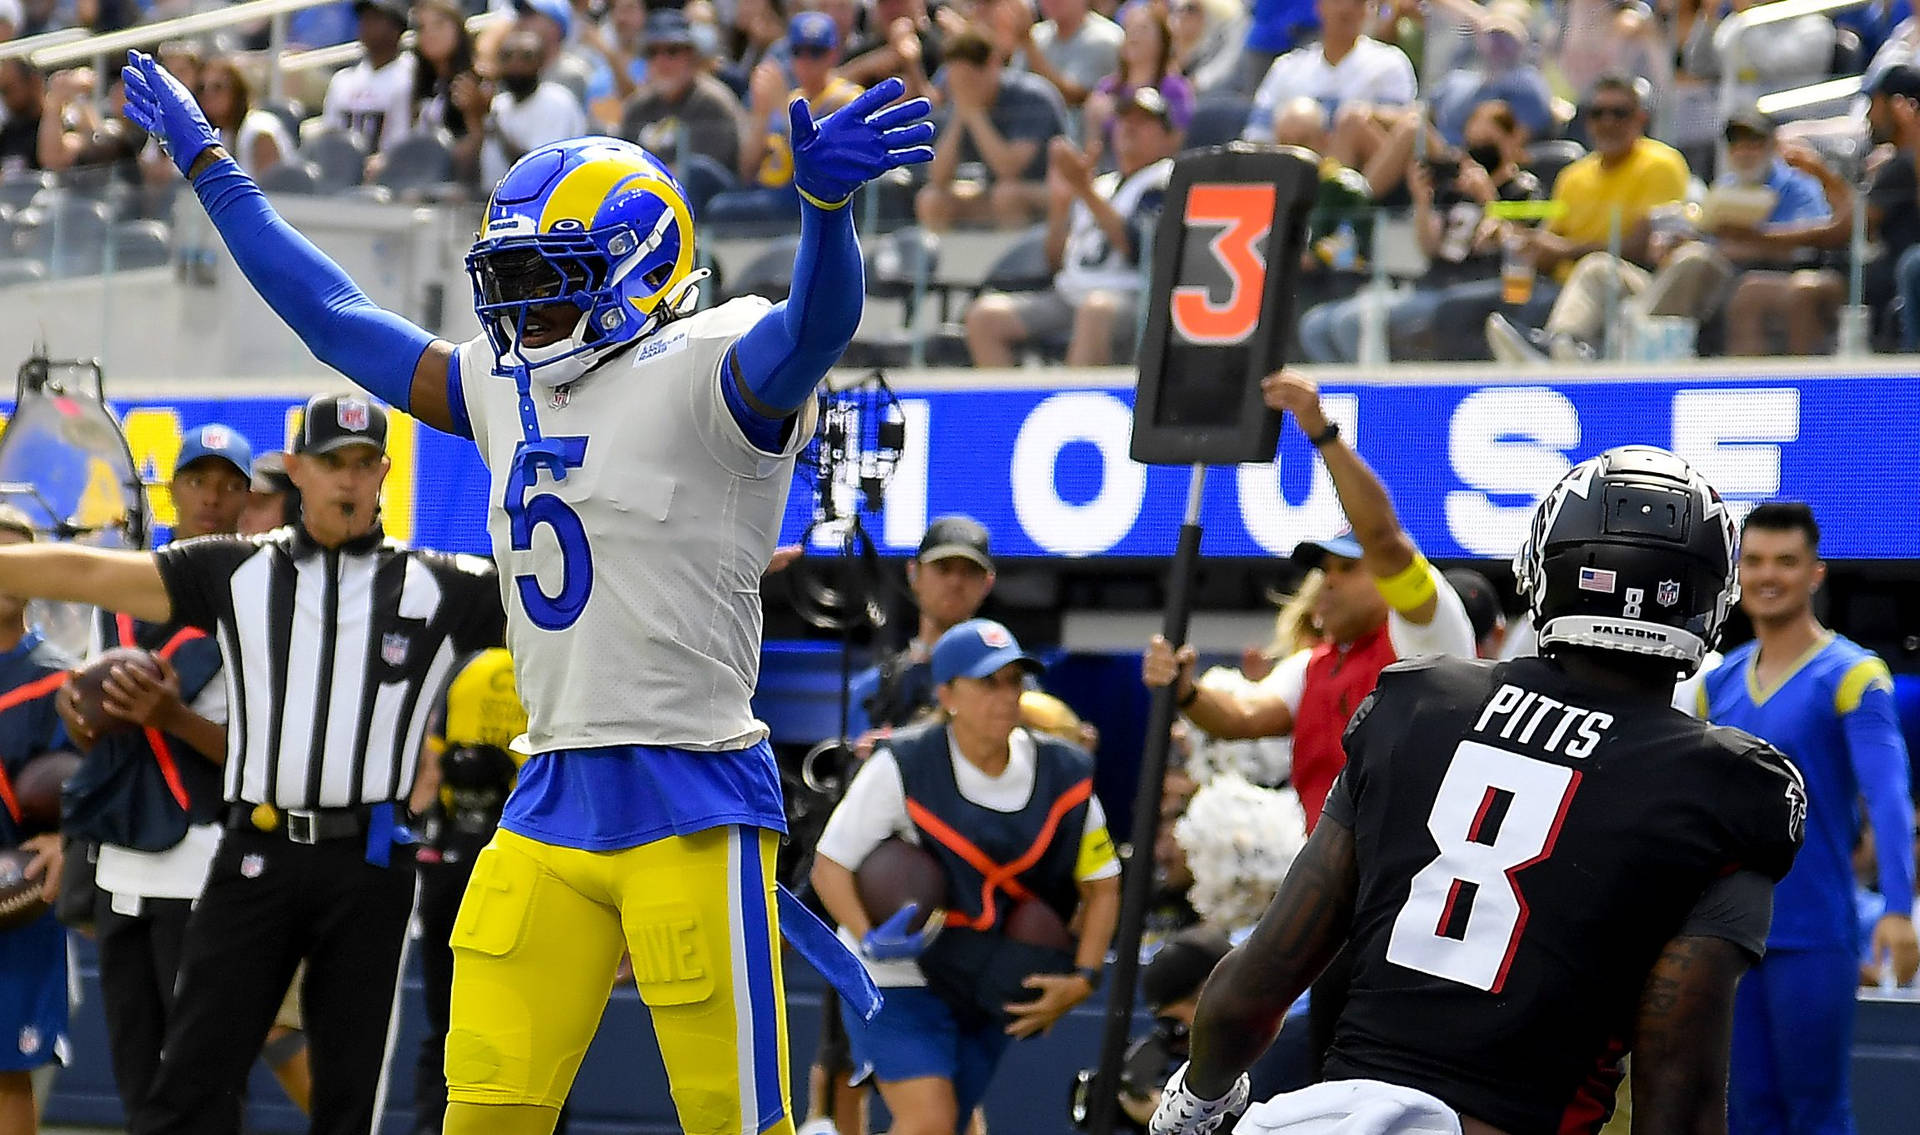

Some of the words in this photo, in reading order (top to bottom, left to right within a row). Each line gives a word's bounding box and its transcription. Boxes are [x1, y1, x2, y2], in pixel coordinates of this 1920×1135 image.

[1171, 183, 1276, 346] 3
[502, 433, 596, 632] 5
[1592, 624, 1668, 642] FALCONS
[1623, 587, 1644, 618] 8
[1474, 683, 1614, 759] PITTS
[1386, 740, 1583, 994] 8
